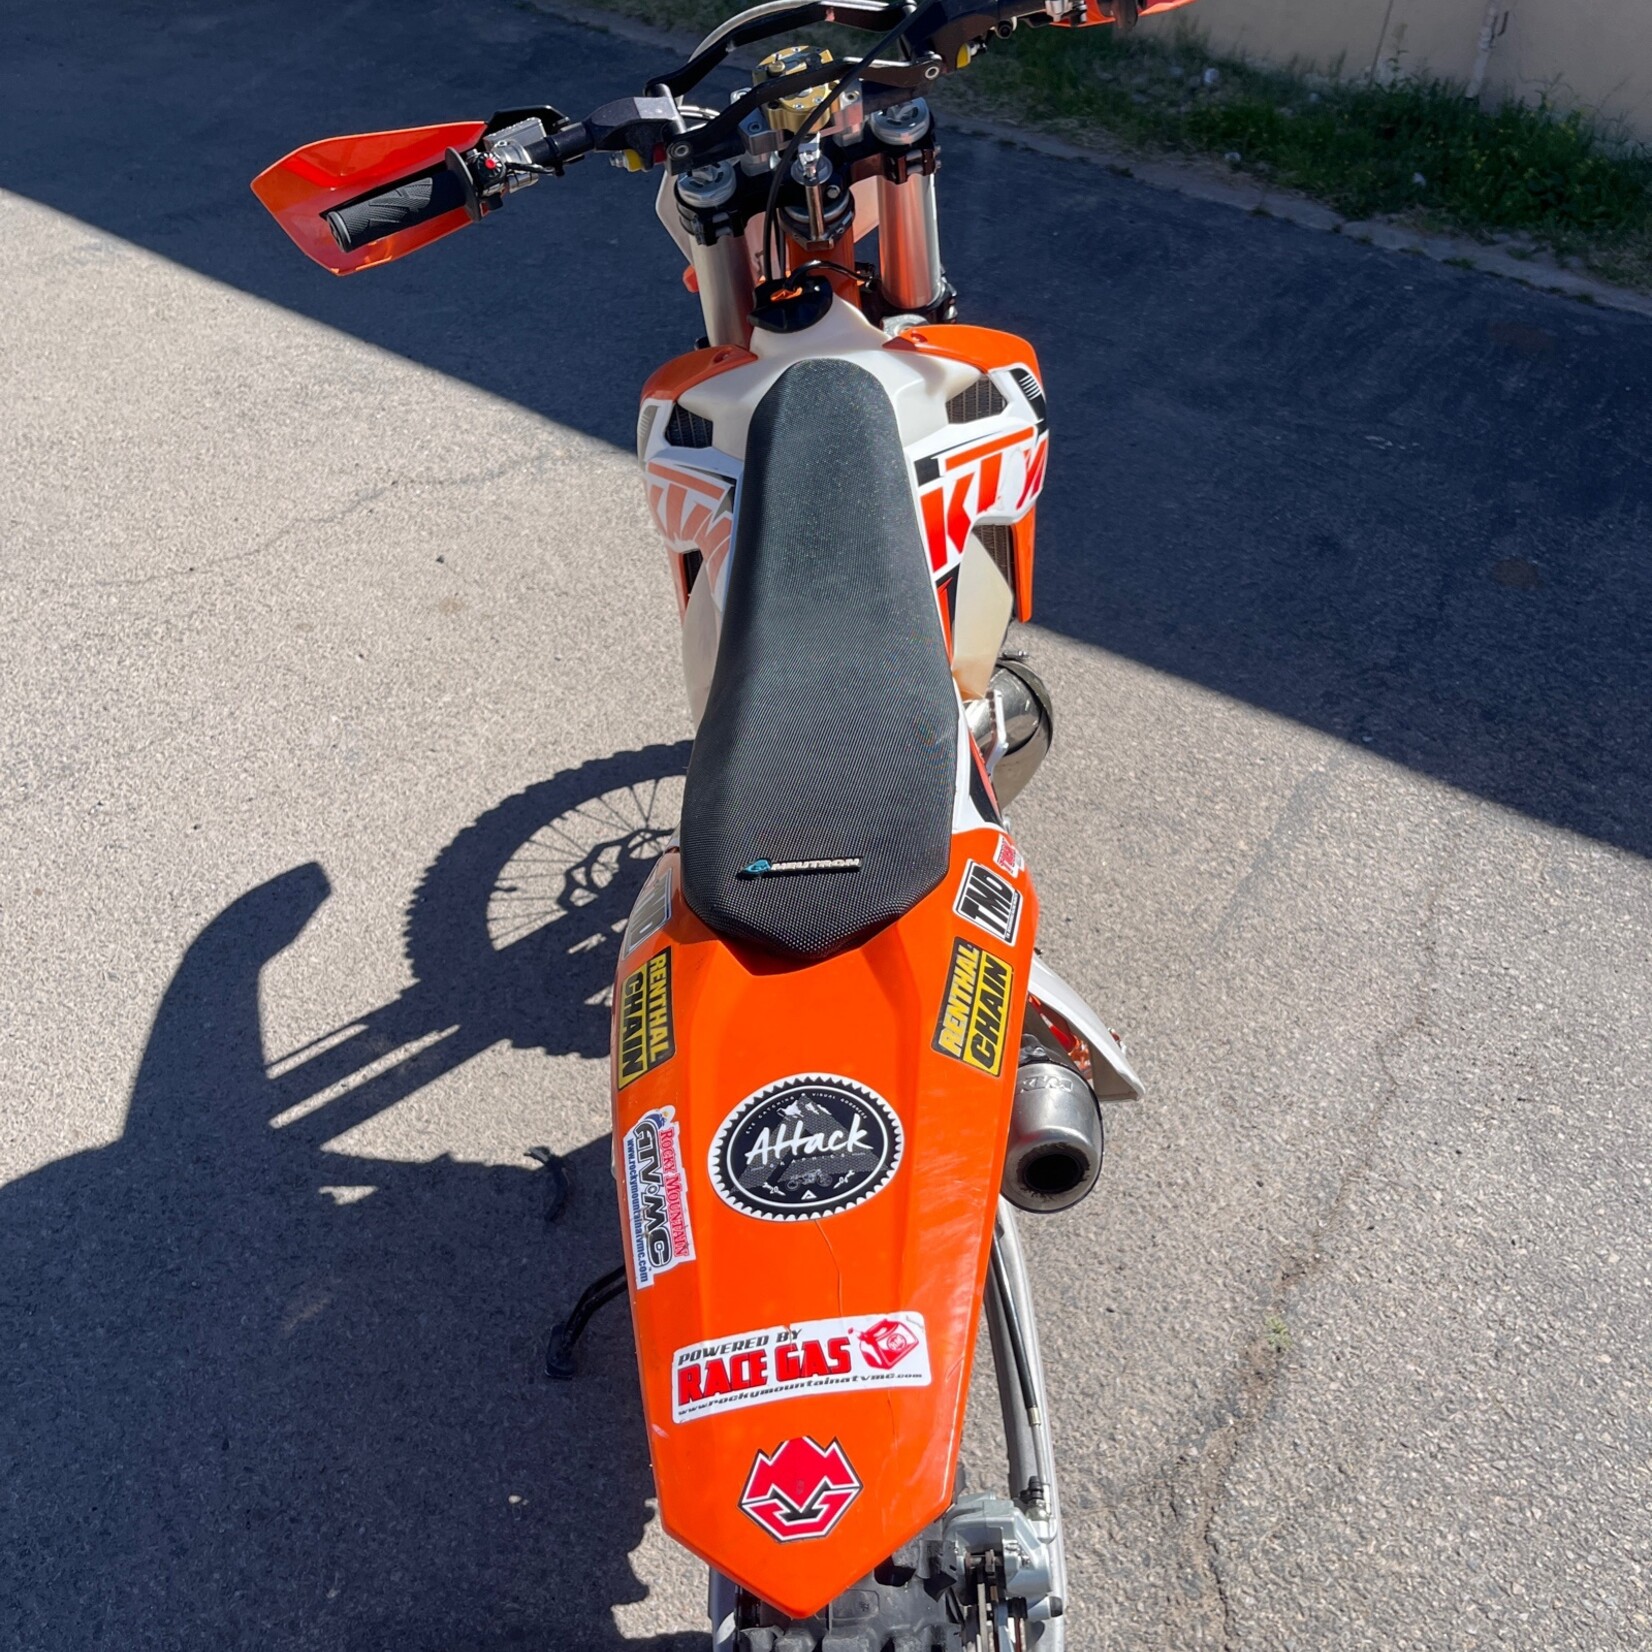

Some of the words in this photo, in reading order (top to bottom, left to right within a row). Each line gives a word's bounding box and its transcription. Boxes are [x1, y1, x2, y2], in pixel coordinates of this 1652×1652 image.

[770, 857, 861, 872] NEUTRON
[960, 864, 1014, 936] TMD
[621, 970, 645, 1078] CHAIN
[649, 951, 670, 1063] RENTHAL
[938, 944, 980, 1058] RENTHAL
[970, 954, 1008, 1069] CHAIN
[811, 1091, 836, 1100] VISUAL
[744, 1112, 874, 1166] Attack
[768, 1152, 846, 1169] GRAPHICS
[677, 1348, 769, 1407] RACE
[773, 1336, 853, 1383] GAS
[678, 1335, 770, 1366] POWERED
[776, 1327, 803, 1343] BY
